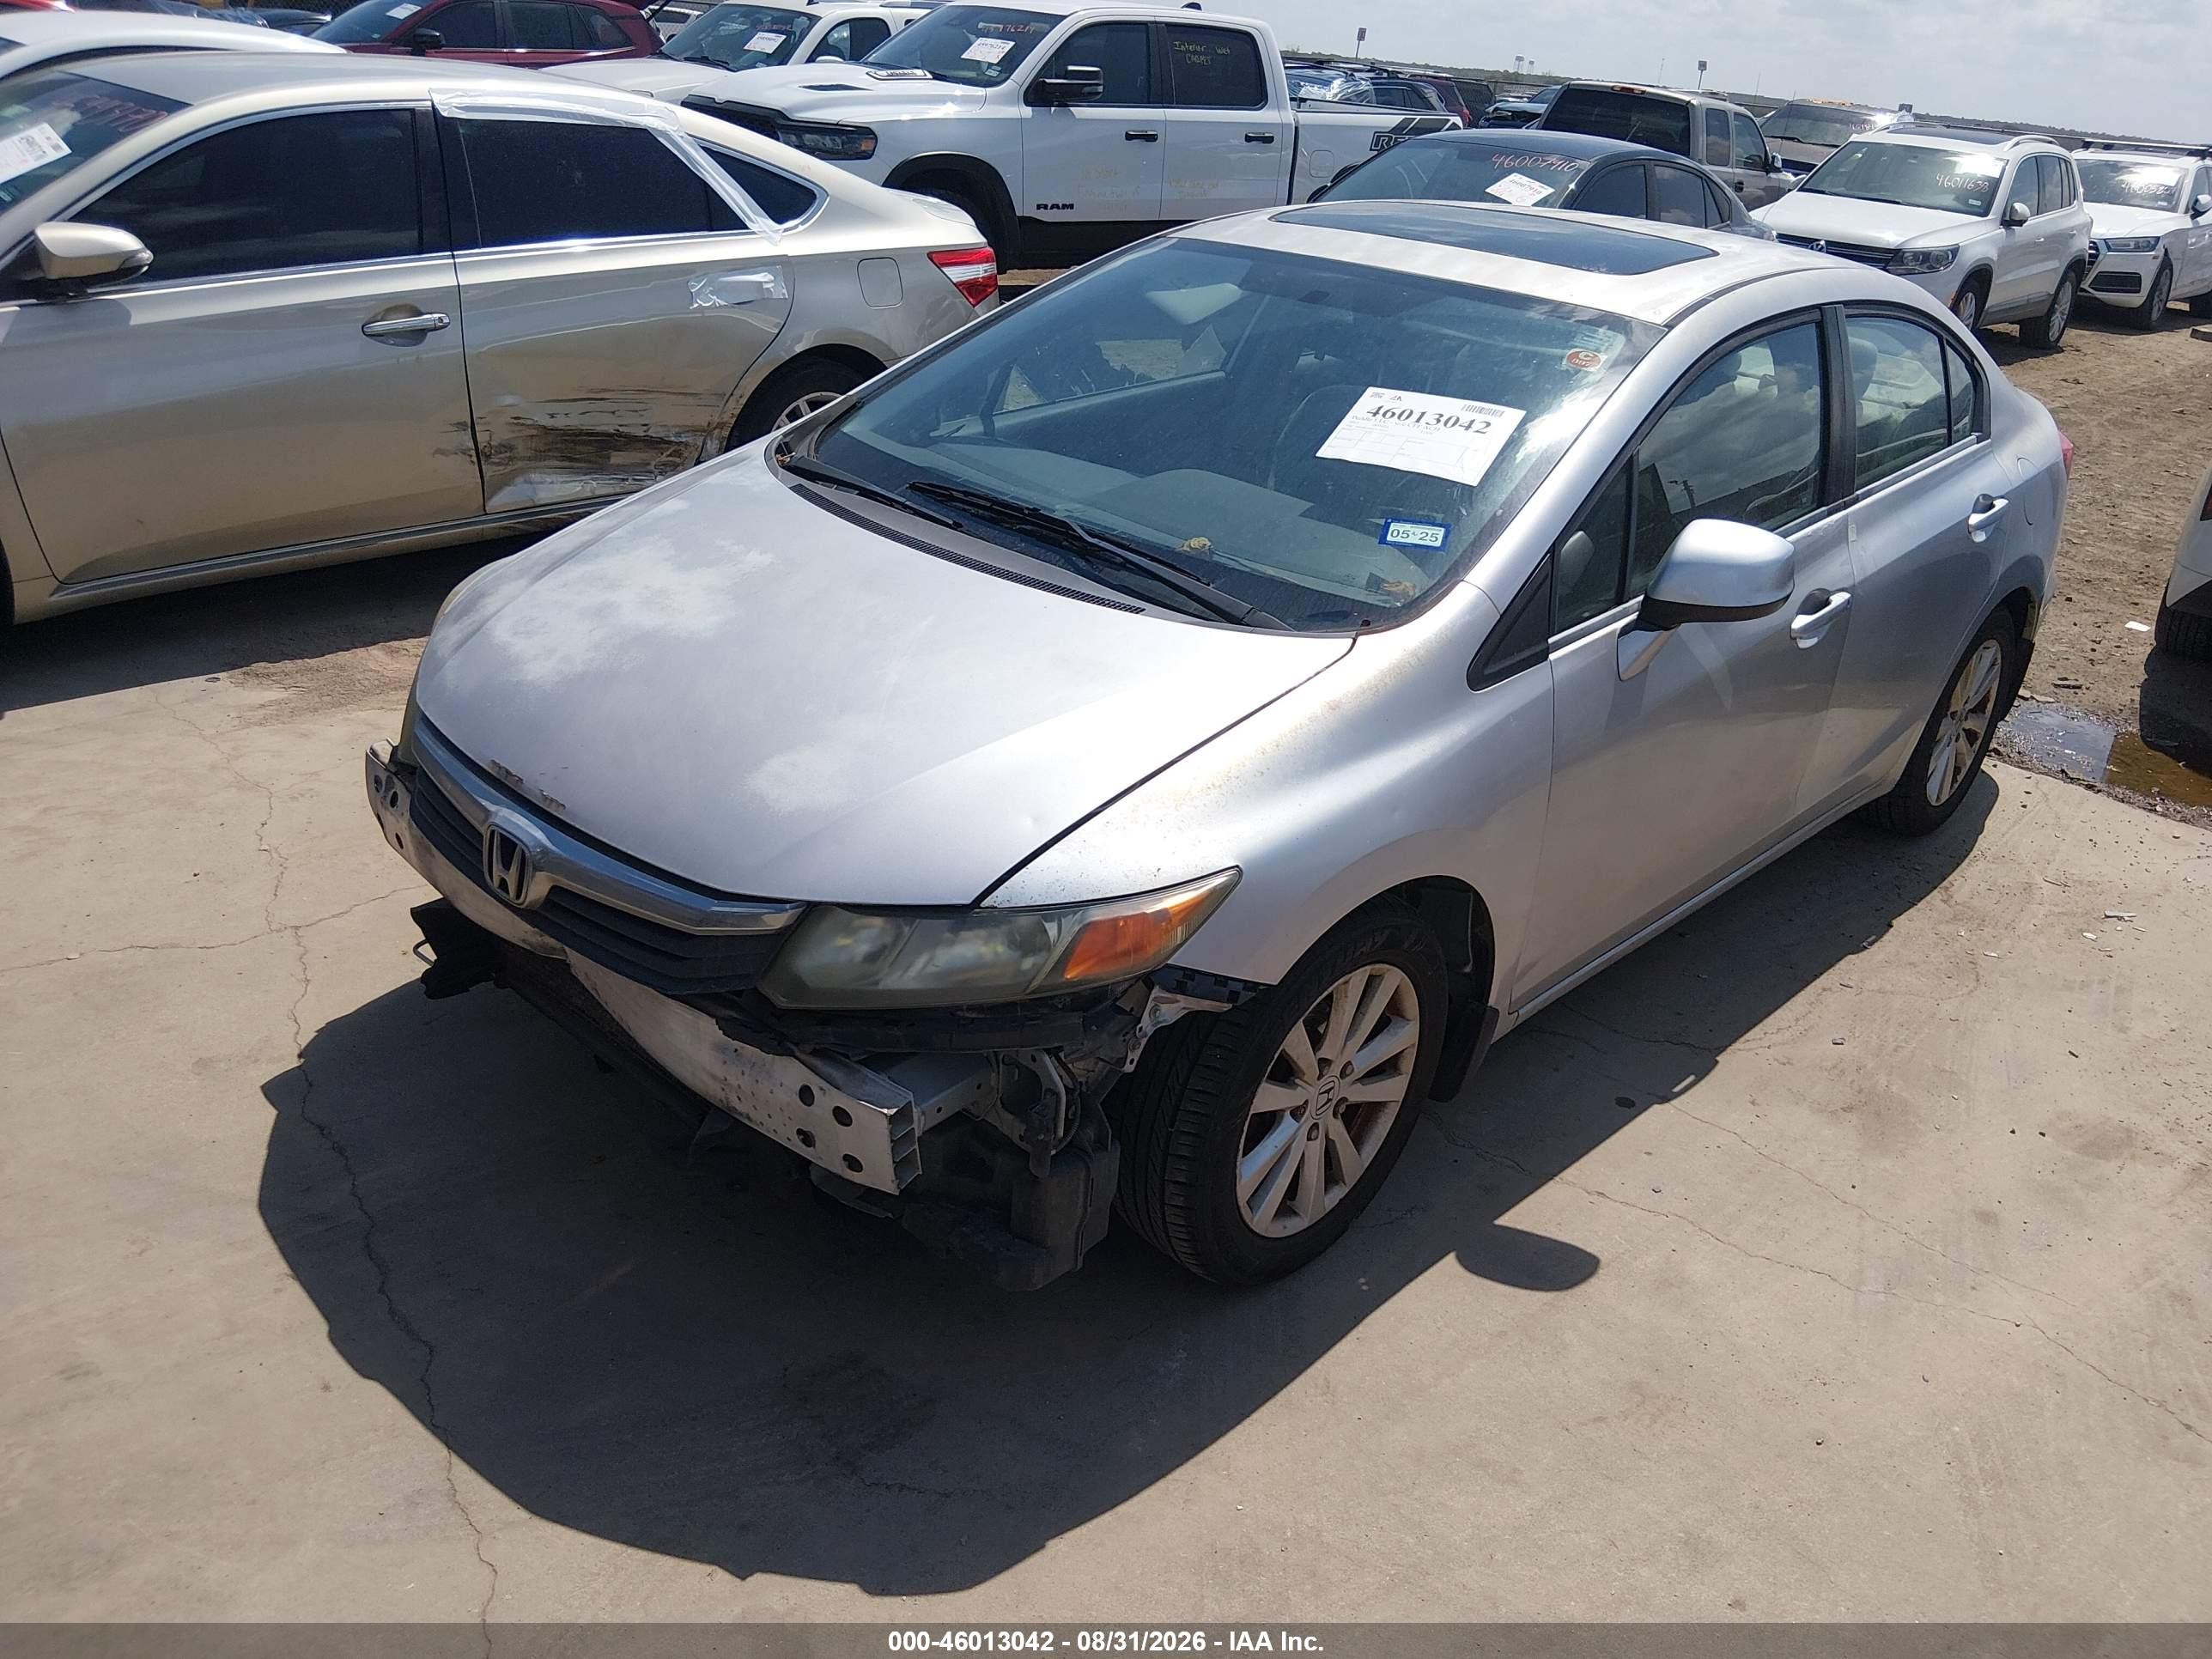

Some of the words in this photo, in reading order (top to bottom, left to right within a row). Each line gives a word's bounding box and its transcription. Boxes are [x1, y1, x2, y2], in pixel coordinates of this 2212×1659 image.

[1366, 404, 1492, 434] 46013042
[1390, 528, 1411, 539] 05
[1419, 532, 1440, 543] 25
